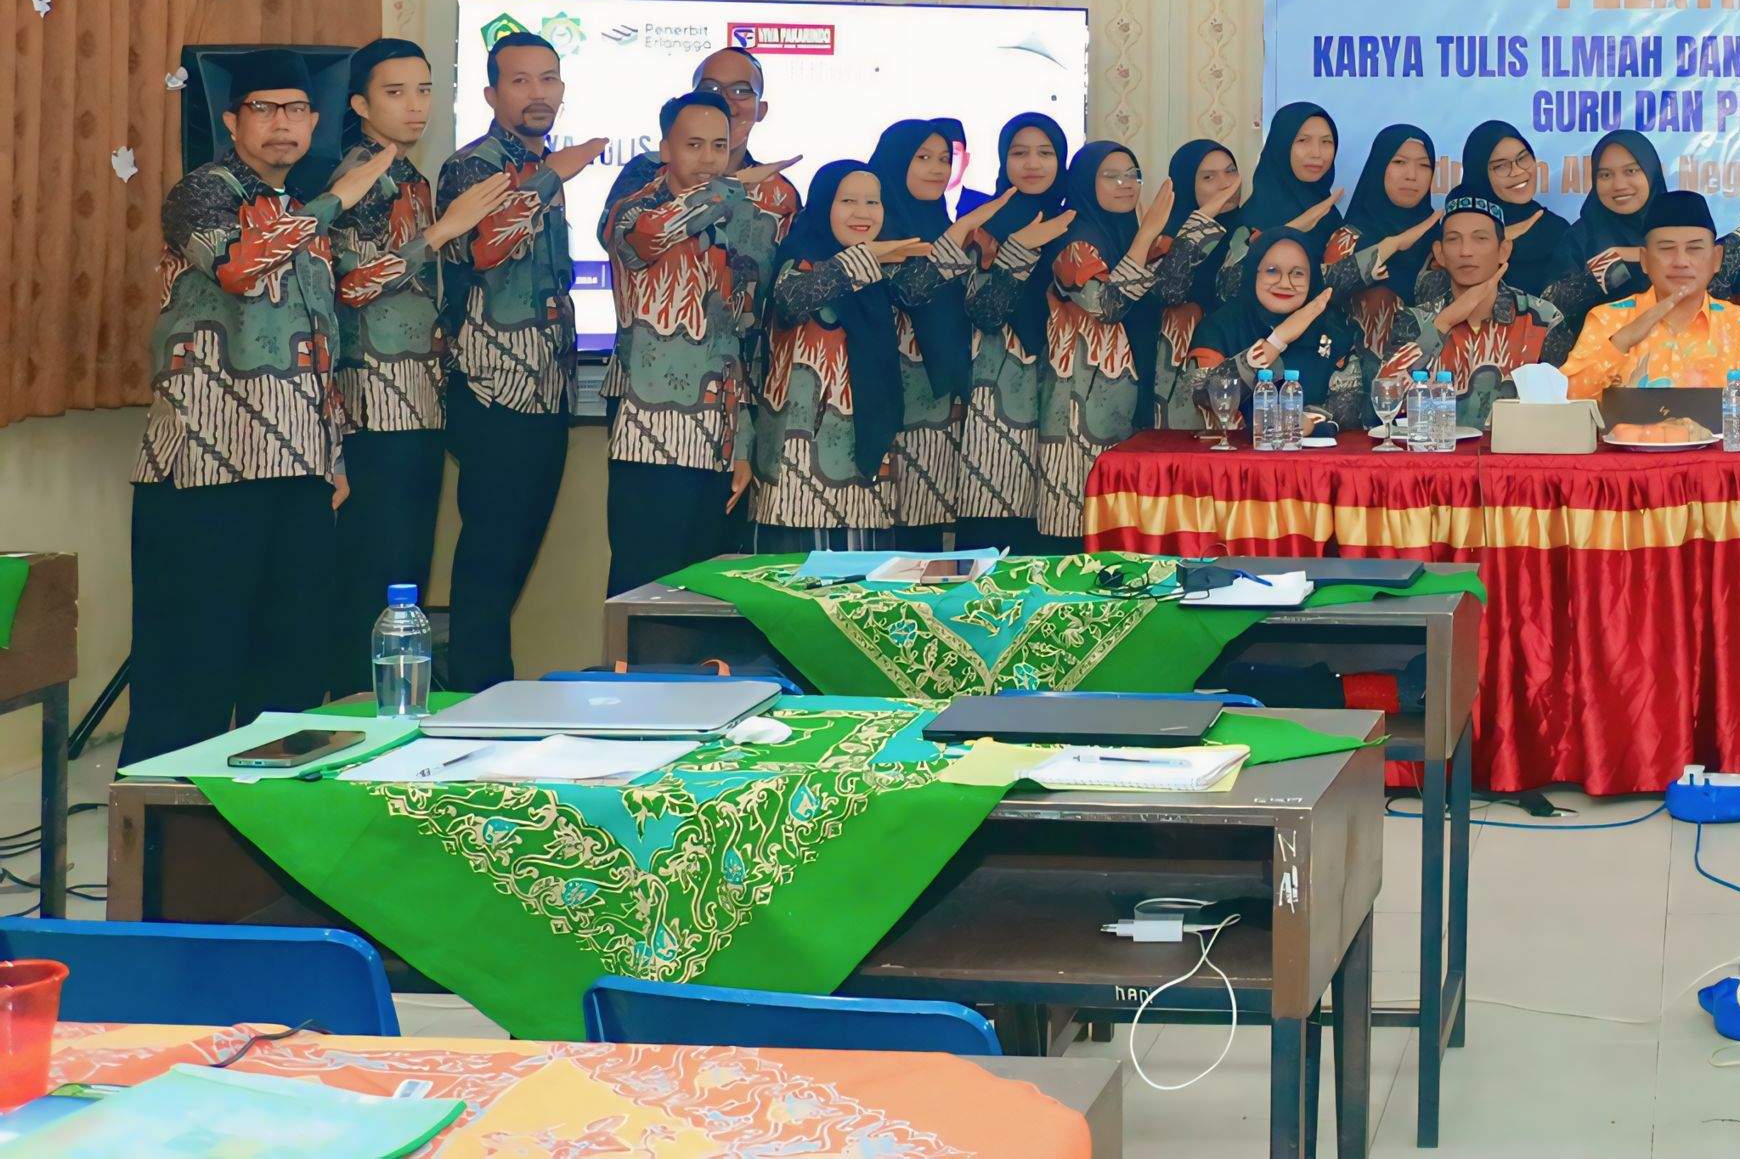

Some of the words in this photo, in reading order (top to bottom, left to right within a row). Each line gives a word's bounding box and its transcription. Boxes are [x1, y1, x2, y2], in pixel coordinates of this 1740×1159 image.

[645, 23, 708, 36] Penerbit
[1313, 35, 1424, 78] KARYA
[1436, 35, 1529, 78] TULIS
[1541, 35, 1663, 78] ILMIAH
[1533, 90, 1622, 133] GURU
[1635, 90, 1703, 133] DAN
